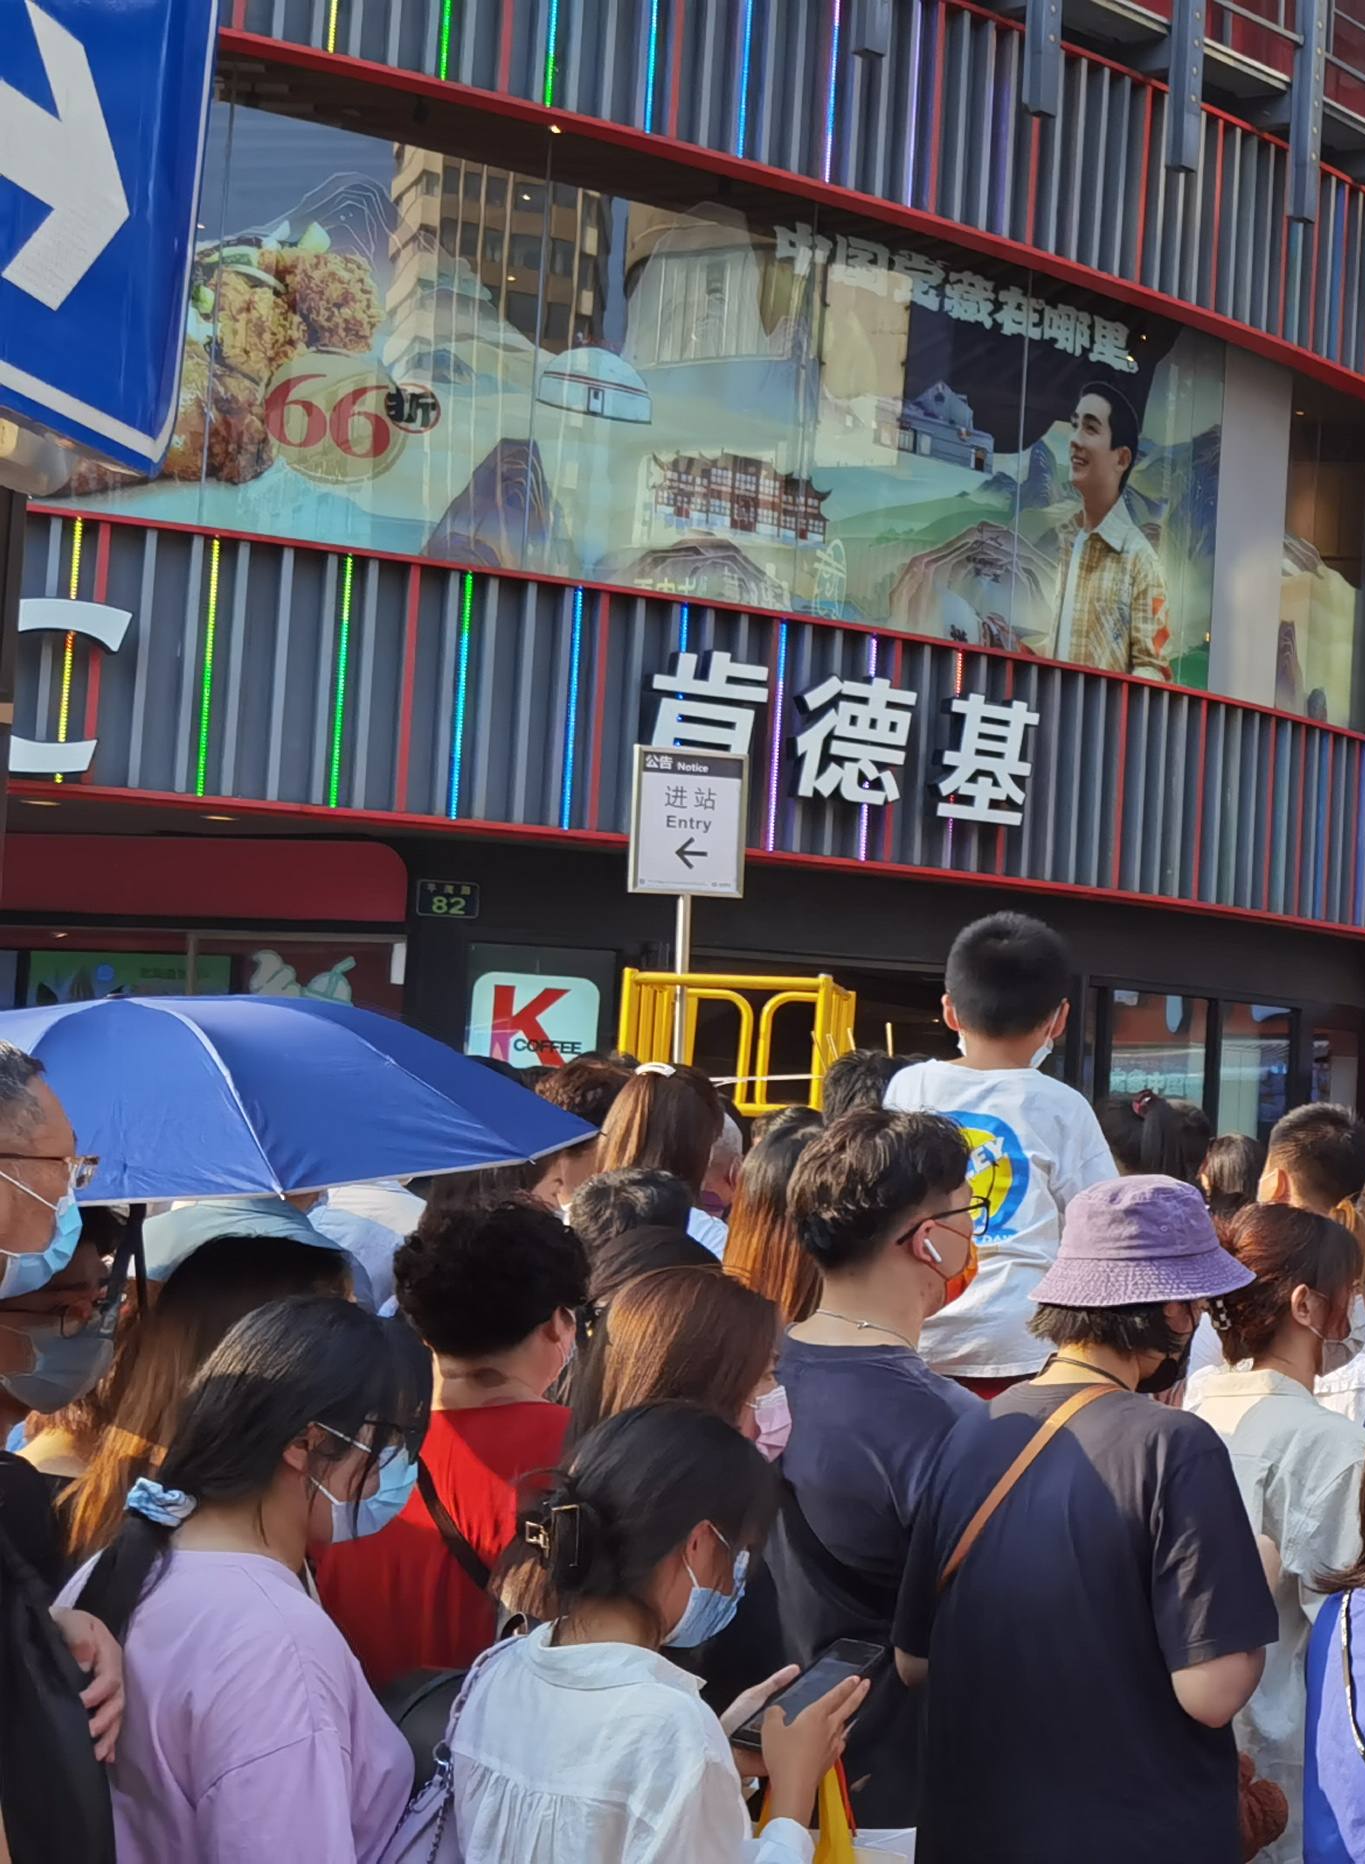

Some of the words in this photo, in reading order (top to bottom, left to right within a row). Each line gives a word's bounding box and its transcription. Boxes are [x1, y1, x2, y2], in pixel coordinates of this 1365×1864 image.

[652, 651, 1040, 826] 肯德基
[645, 754, 673, 770] 公告
[677, 760, 709, 774] Notice
[664, 785, 717, 812] 进站
[665, 816, 713, 834] Entry
[432, 895, 466, 915] 82
[490, 984, 572, 1068] K
[513, 1038, 582, 1055] COFFEE
